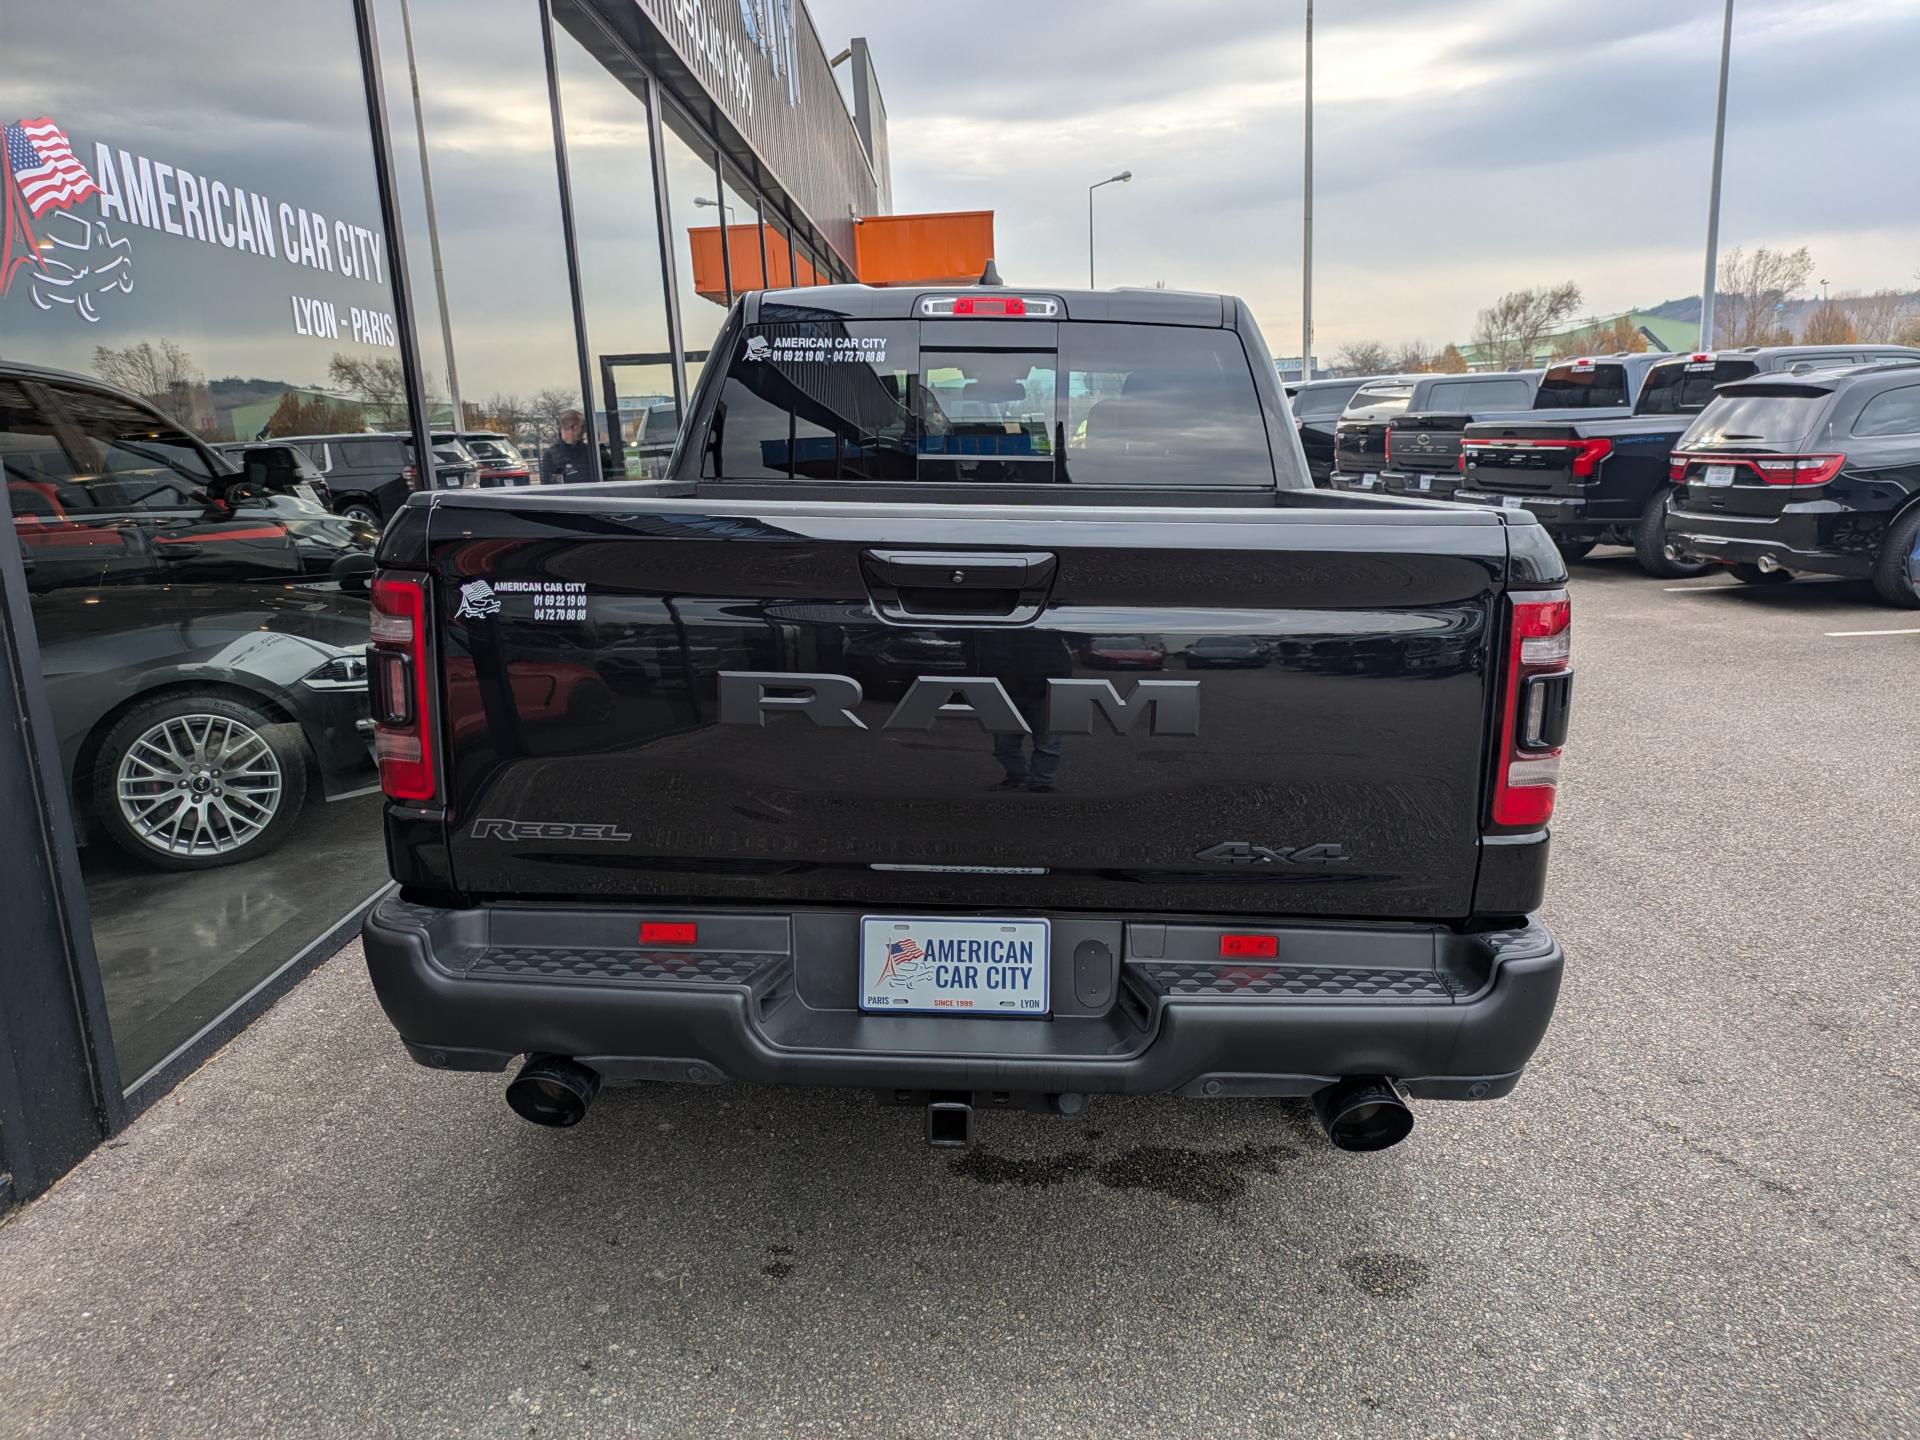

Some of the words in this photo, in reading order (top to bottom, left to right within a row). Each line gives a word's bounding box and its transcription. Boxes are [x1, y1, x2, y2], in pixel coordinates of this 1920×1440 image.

[725, 31, 752, 117] 1999
[95, 142, 276, 258] AMERICAN
[279, 202, 333, 272] CAR
[335, 220, 383, 283] CITY
[291, 296, 338, 339] LYON
[351, 306, 395, 347] PARIS
[773, 337, 832, 348] AMERICAN
[835, 338, 859, 349] CAR
[861, 338, 887, 349] CITY
[773, 351, 782, 362] 01
[783, 351, 793, 362] 69
[794, 351, 804, 362] 22
[805, 351, 813, 362] 19
[833, 351, 843, 362] 04
[844, 351, 854, 362] 72
[855, 351, 864, 362] 70
[494, 582, 541, 592] AMERICAN
[544, 582, 563, 592] CAR
[565, 583, 587, 592] CITY
[534, 595, 543, 606] 01
[545, 595, 554, 606] 69
[556, 595, 565, 606] 22
[567, 595, 576, 606] 19
[534, 609, 544, 620] 04
[546, 609, 555, 620] 72
[556, 609, 565, 620] 70
[717, 670, 1200, 735] RAM
[470, 818, 632, 841] REBEL
[924, 939, 1032, 964] AMERICAN
[935, 965, 979, 989] CAR
[986, 966, 1032, 990] CITY
[868, 996, 889, 1005] PARIS
[1020, 1000, 1040, 1008] LYON
